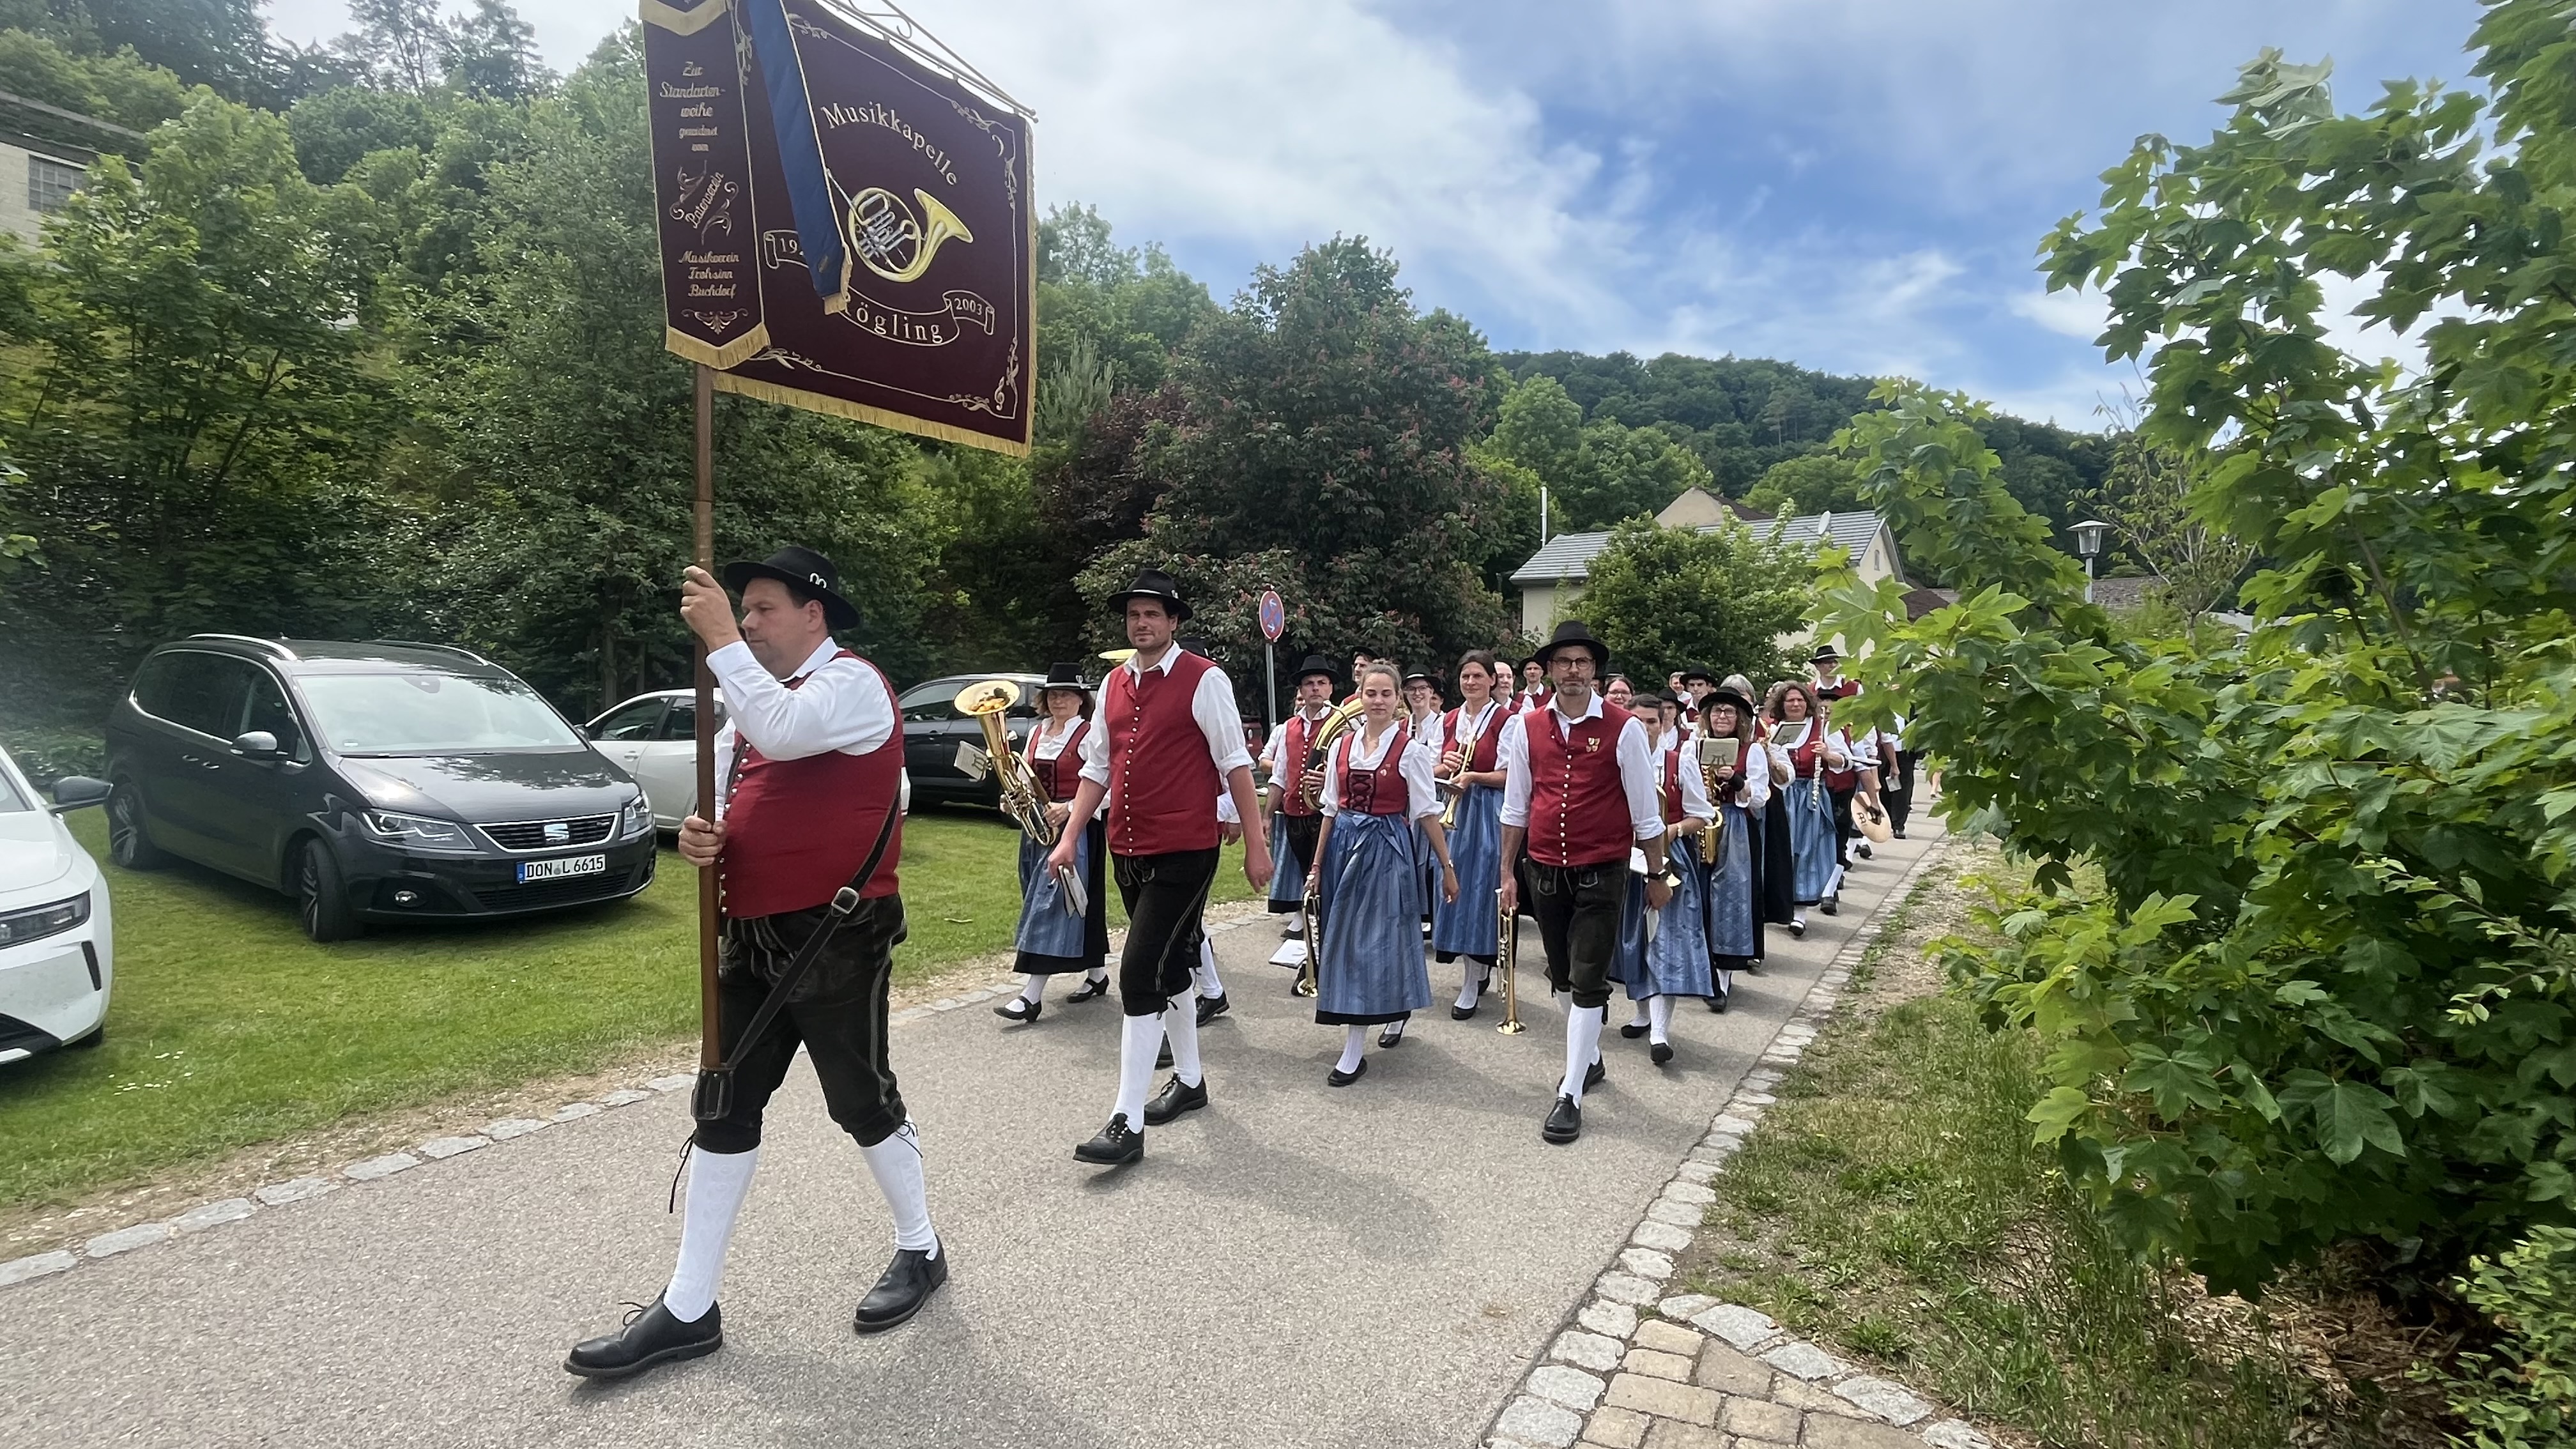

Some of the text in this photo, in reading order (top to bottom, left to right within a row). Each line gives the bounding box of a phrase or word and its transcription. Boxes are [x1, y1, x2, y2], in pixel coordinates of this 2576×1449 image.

[682, 61, 703, 76] Zur
[659, 81, 726, 98] Standarten-
[680, 102, 714, 117] weihe
[821, 101, 958, 185] Musikkapelle
[685, 172, 724, 229] Patenverein
[678, 250, 740, 263] Musikverein
[688, 266, 733, 279] Frohsinn
[688, 284, 737, 299] Buchdorf
[955, 298, 983, 316] 2003
[845, 302, 944, 344] ögling
[526, 857, 603, 878] DON L 6615
